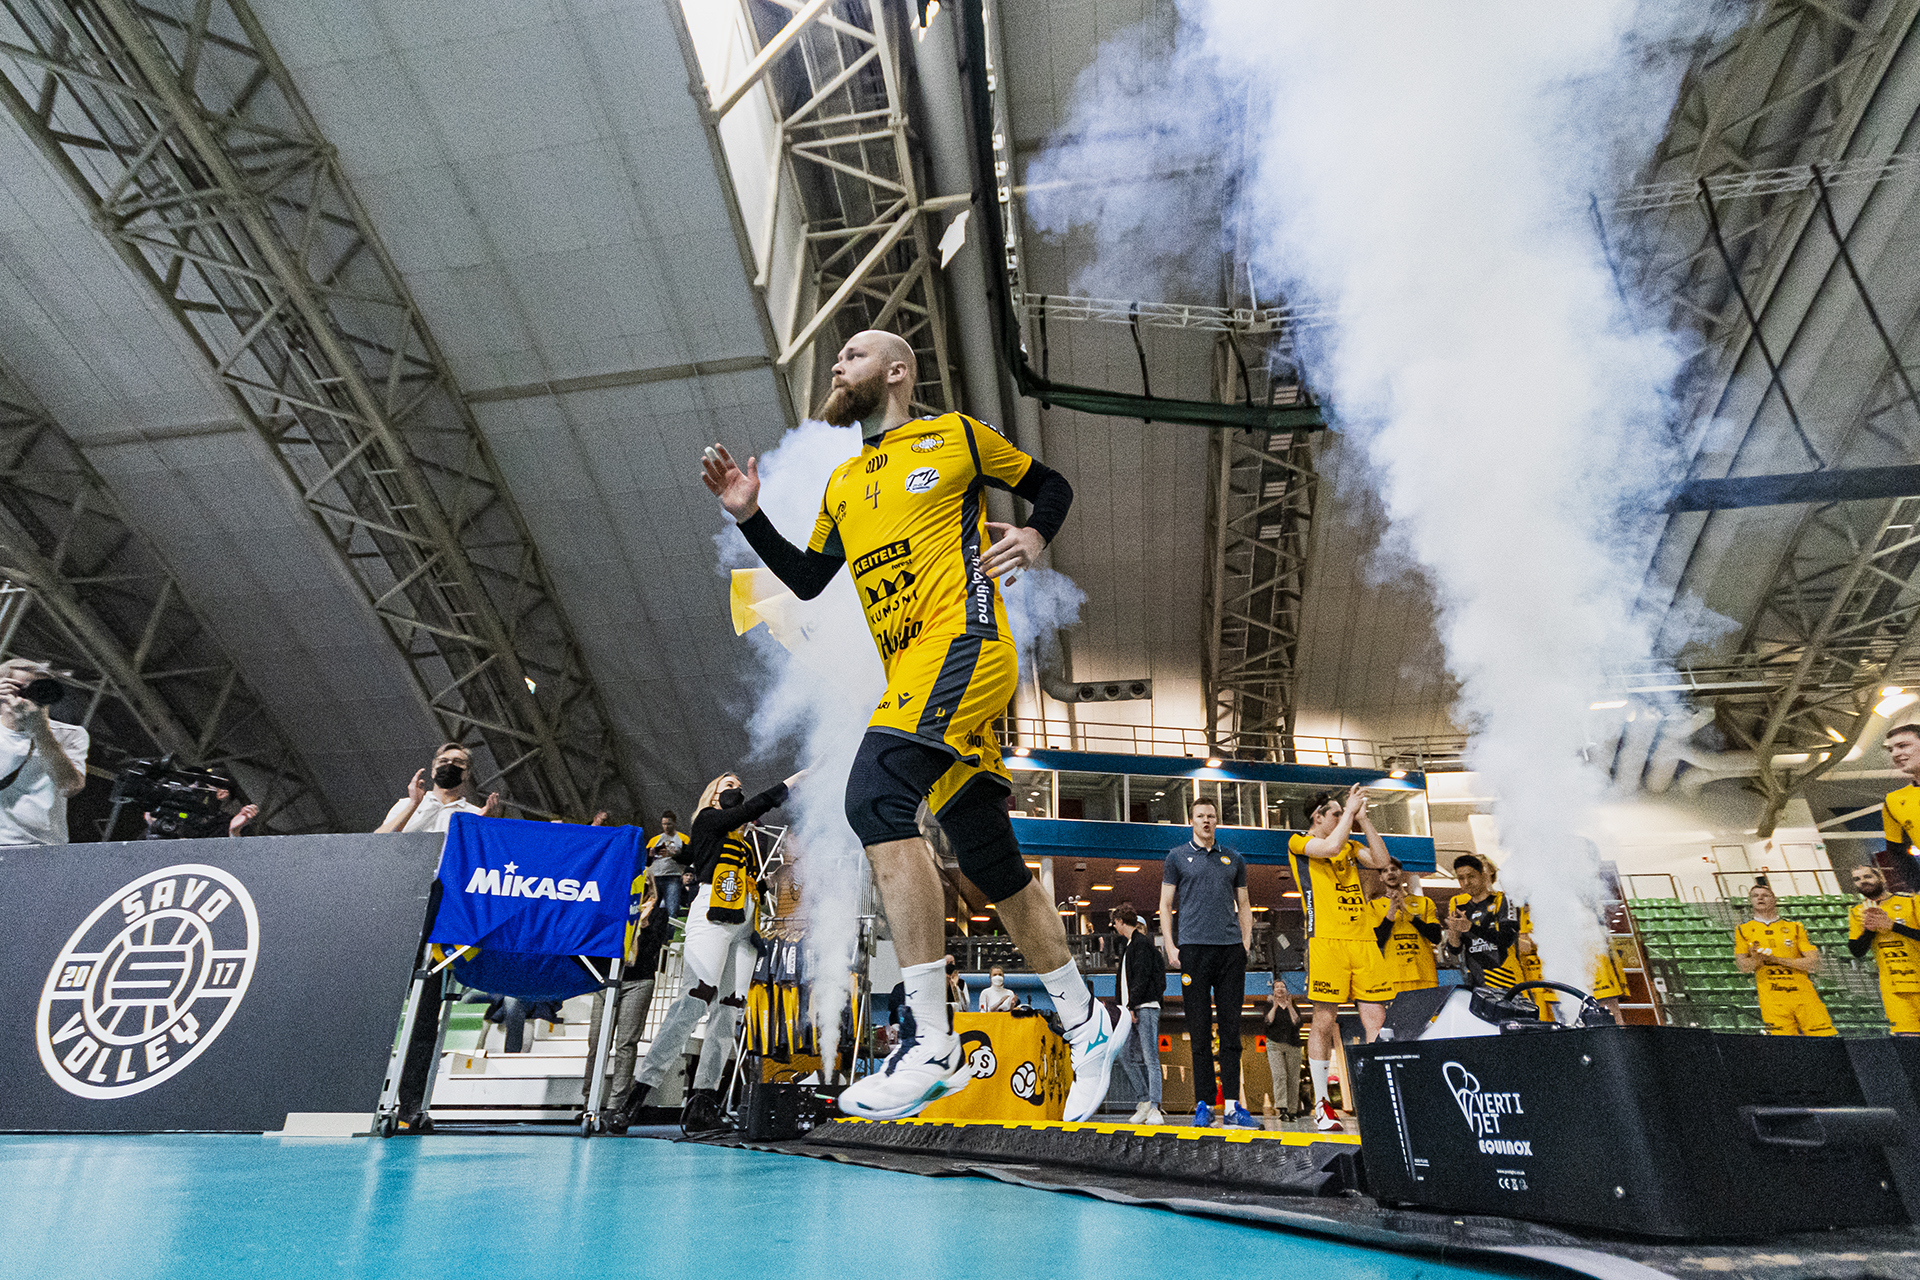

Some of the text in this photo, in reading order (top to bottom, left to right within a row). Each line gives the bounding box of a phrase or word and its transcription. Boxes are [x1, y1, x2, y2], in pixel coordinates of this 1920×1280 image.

[864, 480, 881, 510] 4
[854, 543, 906, 575] KEITELE
[121, 878, 232, 924] SAVO
[59, 962, 238, 987] 20 17
[51, 1012, 200, 1083] VOLLEY
[980, 1054, 990, 1069] S
[1475, 1092, 1524, 1114] VERTI
[1473, 1112, 1500, 1138] JET
